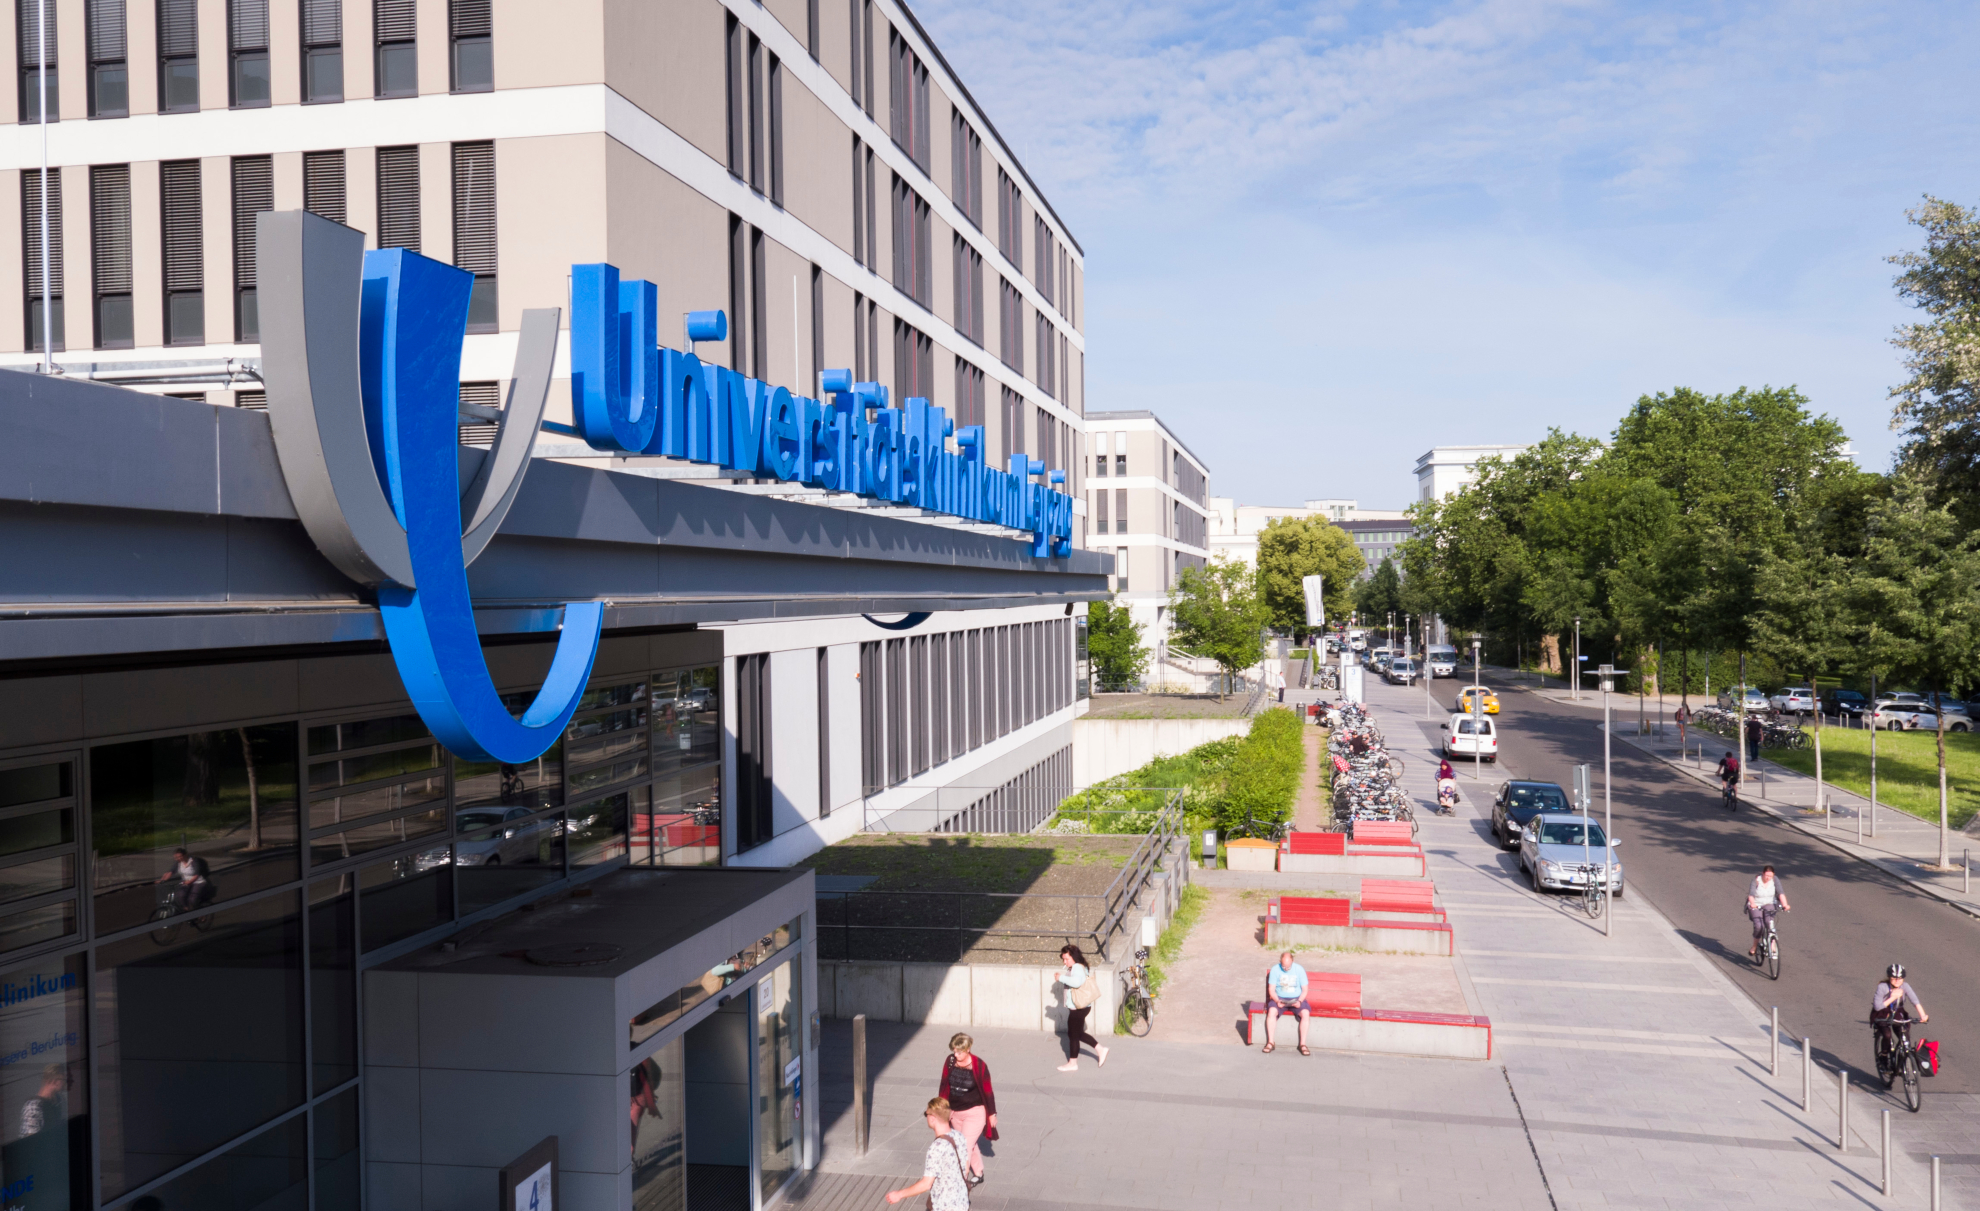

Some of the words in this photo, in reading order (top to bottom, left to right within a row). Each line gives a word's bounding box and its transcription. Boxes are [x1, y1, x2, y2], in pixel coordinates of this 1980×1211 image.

[1011, 453, 1074, 559] Leipzig
[0, 972, 76, 1009] linikum
[529, 1180, 540, 1211] 4
